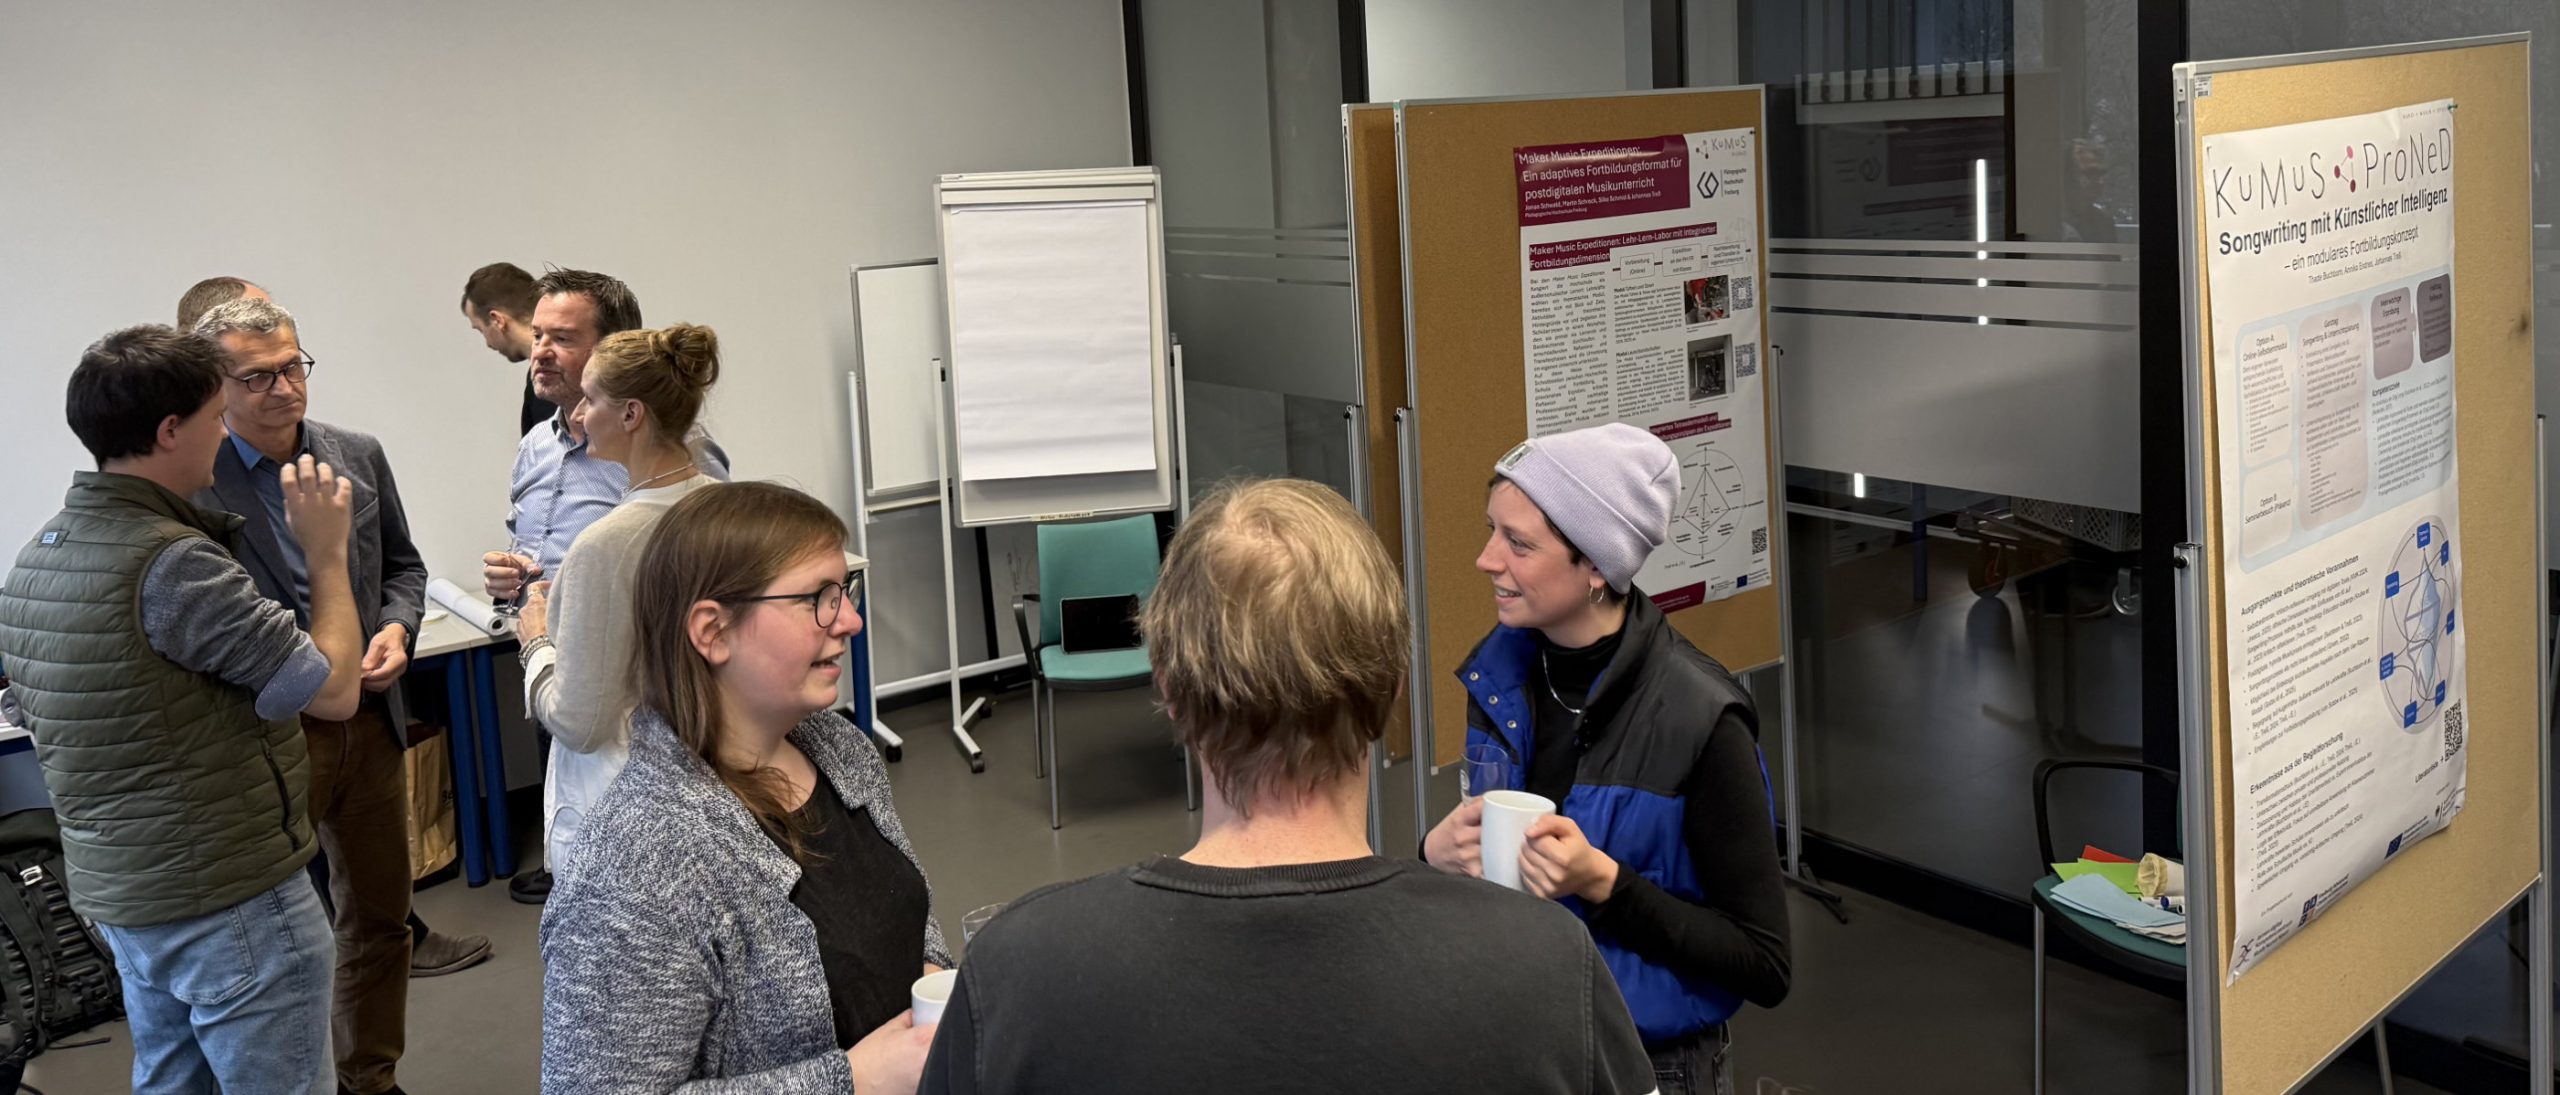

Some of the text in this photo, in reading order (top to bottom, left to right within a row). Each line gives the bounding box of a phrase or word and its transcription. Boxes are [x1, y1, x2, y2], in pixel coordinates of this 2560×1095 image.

[1518, 152, 1548, 165] Maker
[1551, 150, 1578, 162] Music
[1522, 157, 1682, 181] Ein adaptives Fortbildungsformat für
[2212, 127, 2451, 219] KuMuS ProNeD
[1525, 177, 1654, 201] postdigitalen Musikunterricht
[2219, 187, 2447, 256] Songwriting mit Künstlicher Intelligenz
[1529, 246, 1553, 256] Maker
[1555, 244, 1575, 253] Music
[1576, 238, 1621, 250] Expeditionen:
[1673, 229, 1682, 238] mit
[2292, 254, 2305, 271] ein
[2307, 246, 2348, 266] modulares
[2350, 224, 2418, 256] Fortbildungskonzept
[1530, 251, 1609, 270] Fortbildungsdimension
[2283, 583, 2293, 596] und
[2294, 570, 2325, 591] theoretische
[2284, 762, 2293, 774] aus
[2294, 757, 2302, 768] der
